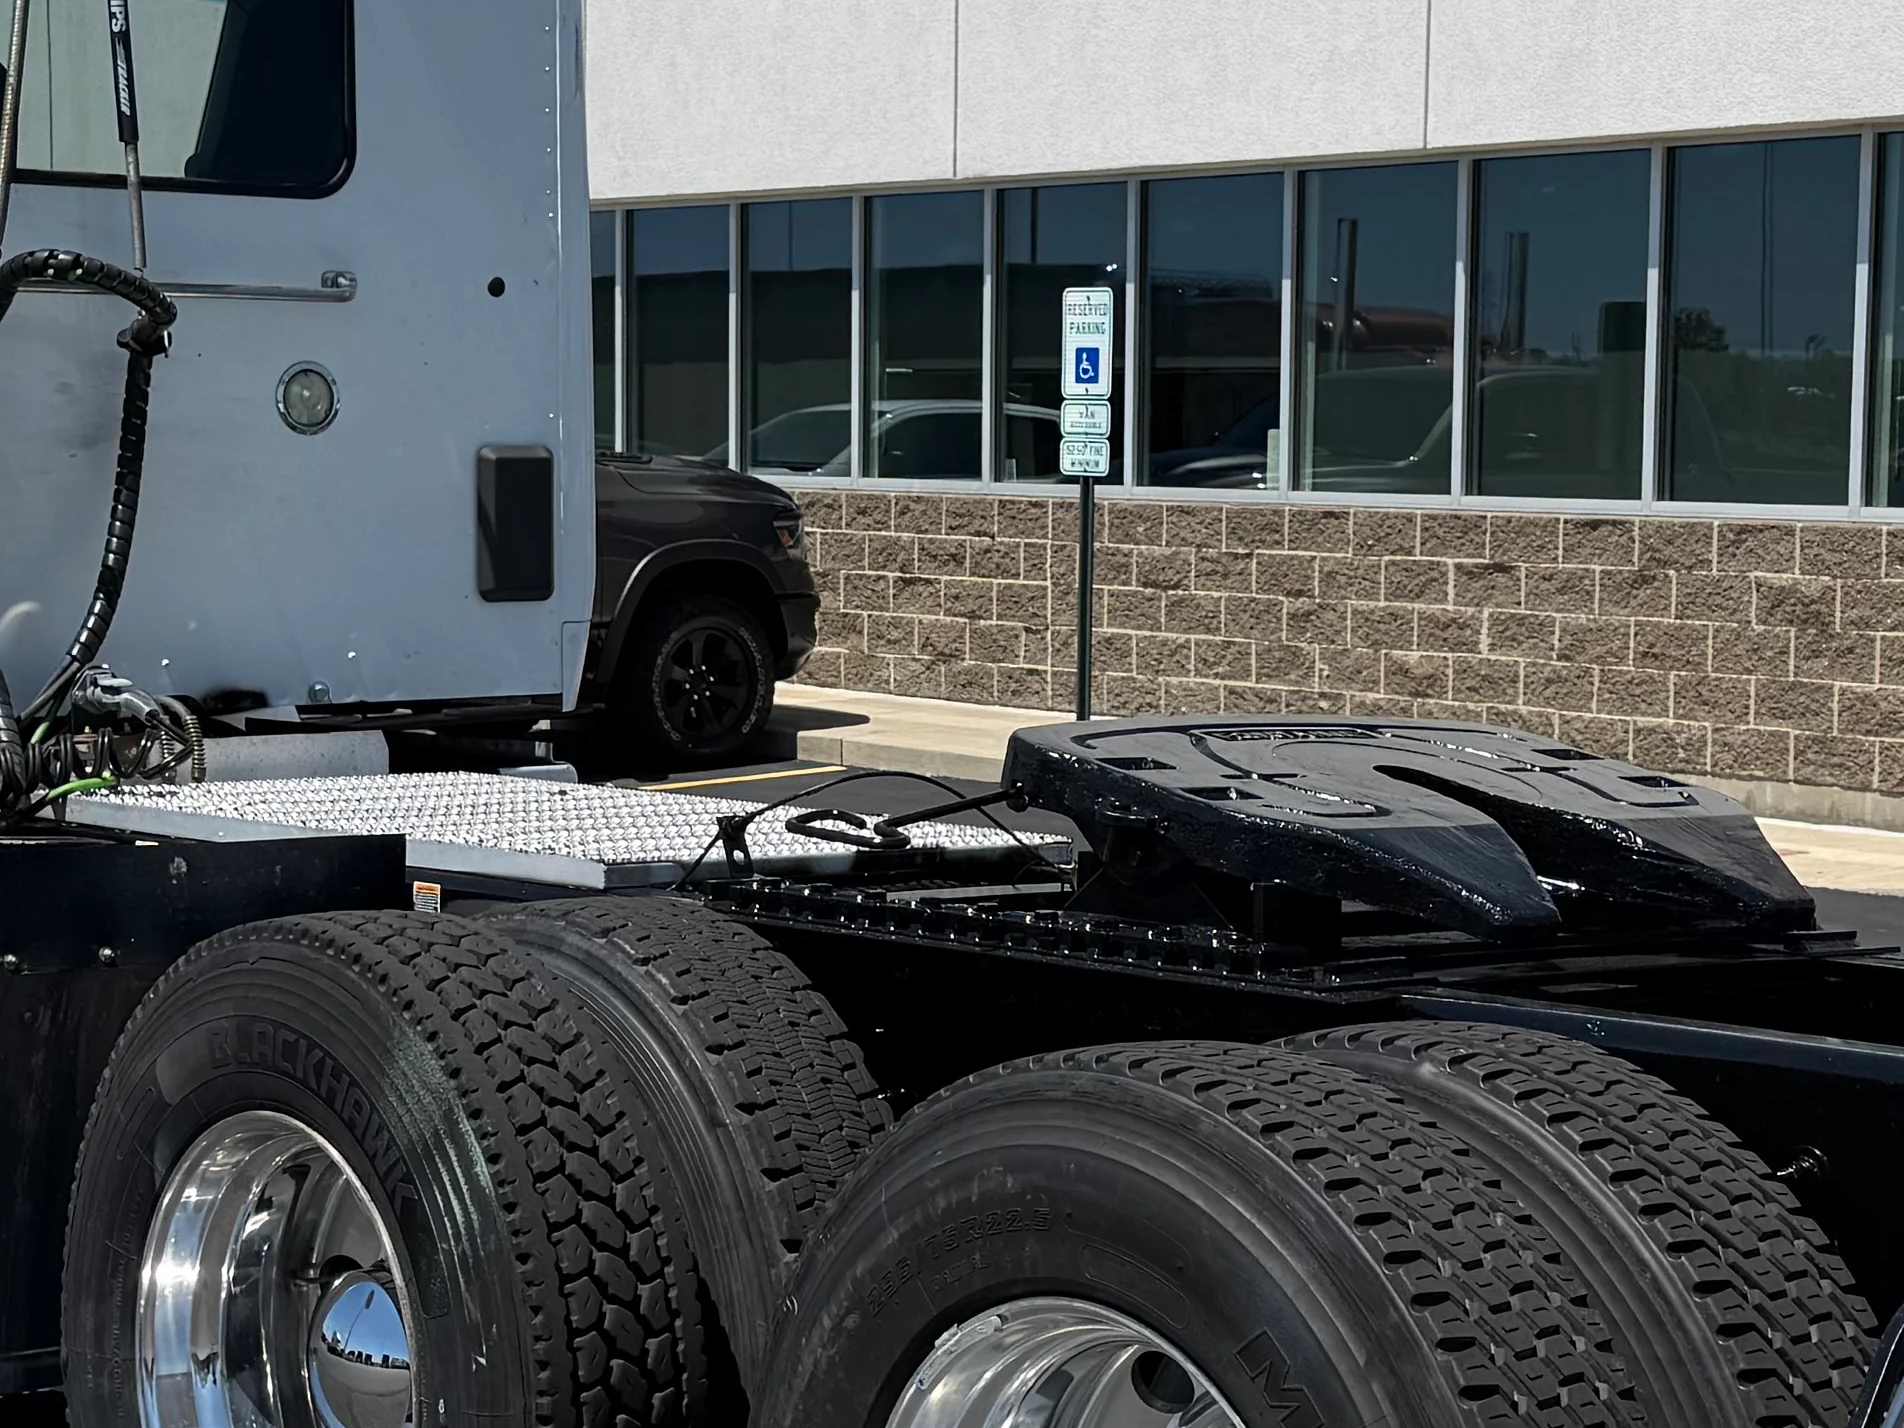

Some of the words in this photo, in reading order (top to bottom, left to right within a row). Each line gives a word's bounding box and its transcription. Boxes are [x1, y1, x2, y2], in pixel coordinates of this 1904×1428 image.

[1067, 303, 1108, 316] RESERVED
[1070, 321, 1106, 335] PARKING
[208, 1020, 419, 1218] BLACKHAWK
